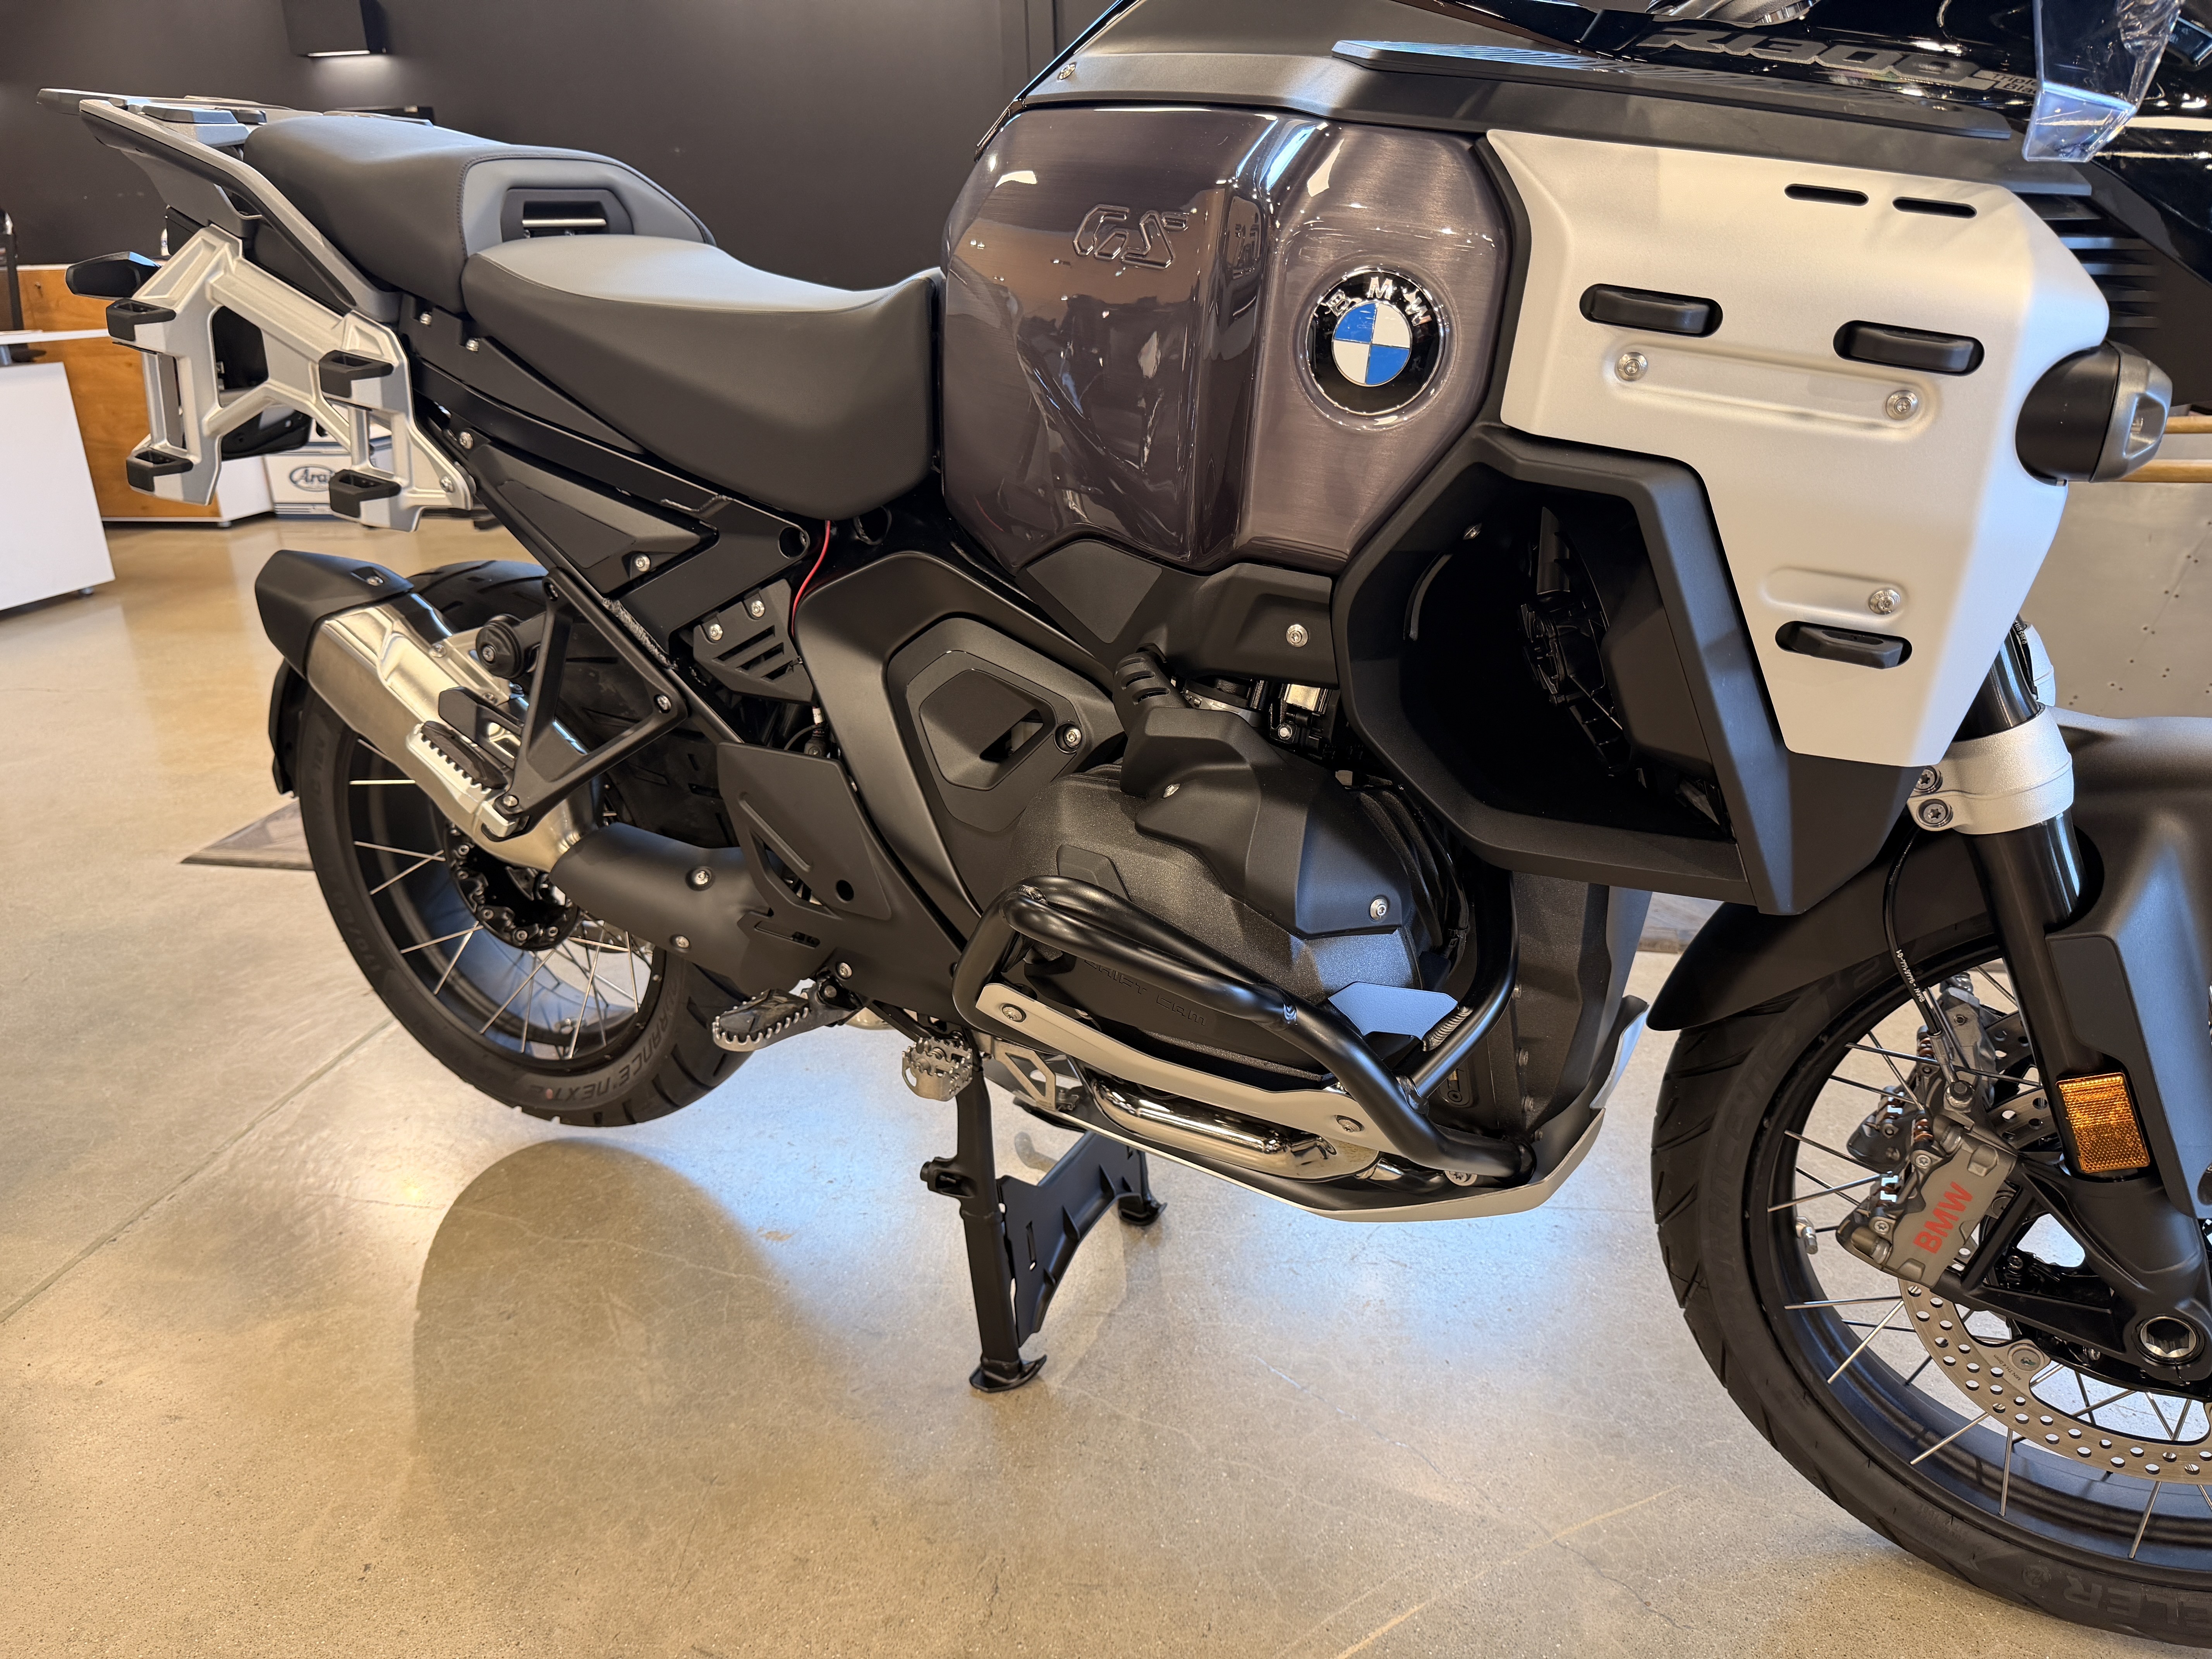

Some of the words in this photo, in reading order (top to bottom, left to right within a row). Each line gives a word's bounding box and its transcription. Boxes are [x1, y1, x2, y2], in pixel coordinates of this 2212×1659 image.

[1073, 203, 1189, 270] GS
[1324, 276, 1433, 327] BMW
[295, 468, 330, 483] Ara
[1913, 1181, 1973, 1254] BMW
[2063, 1574, 2212, 1626] ELER
